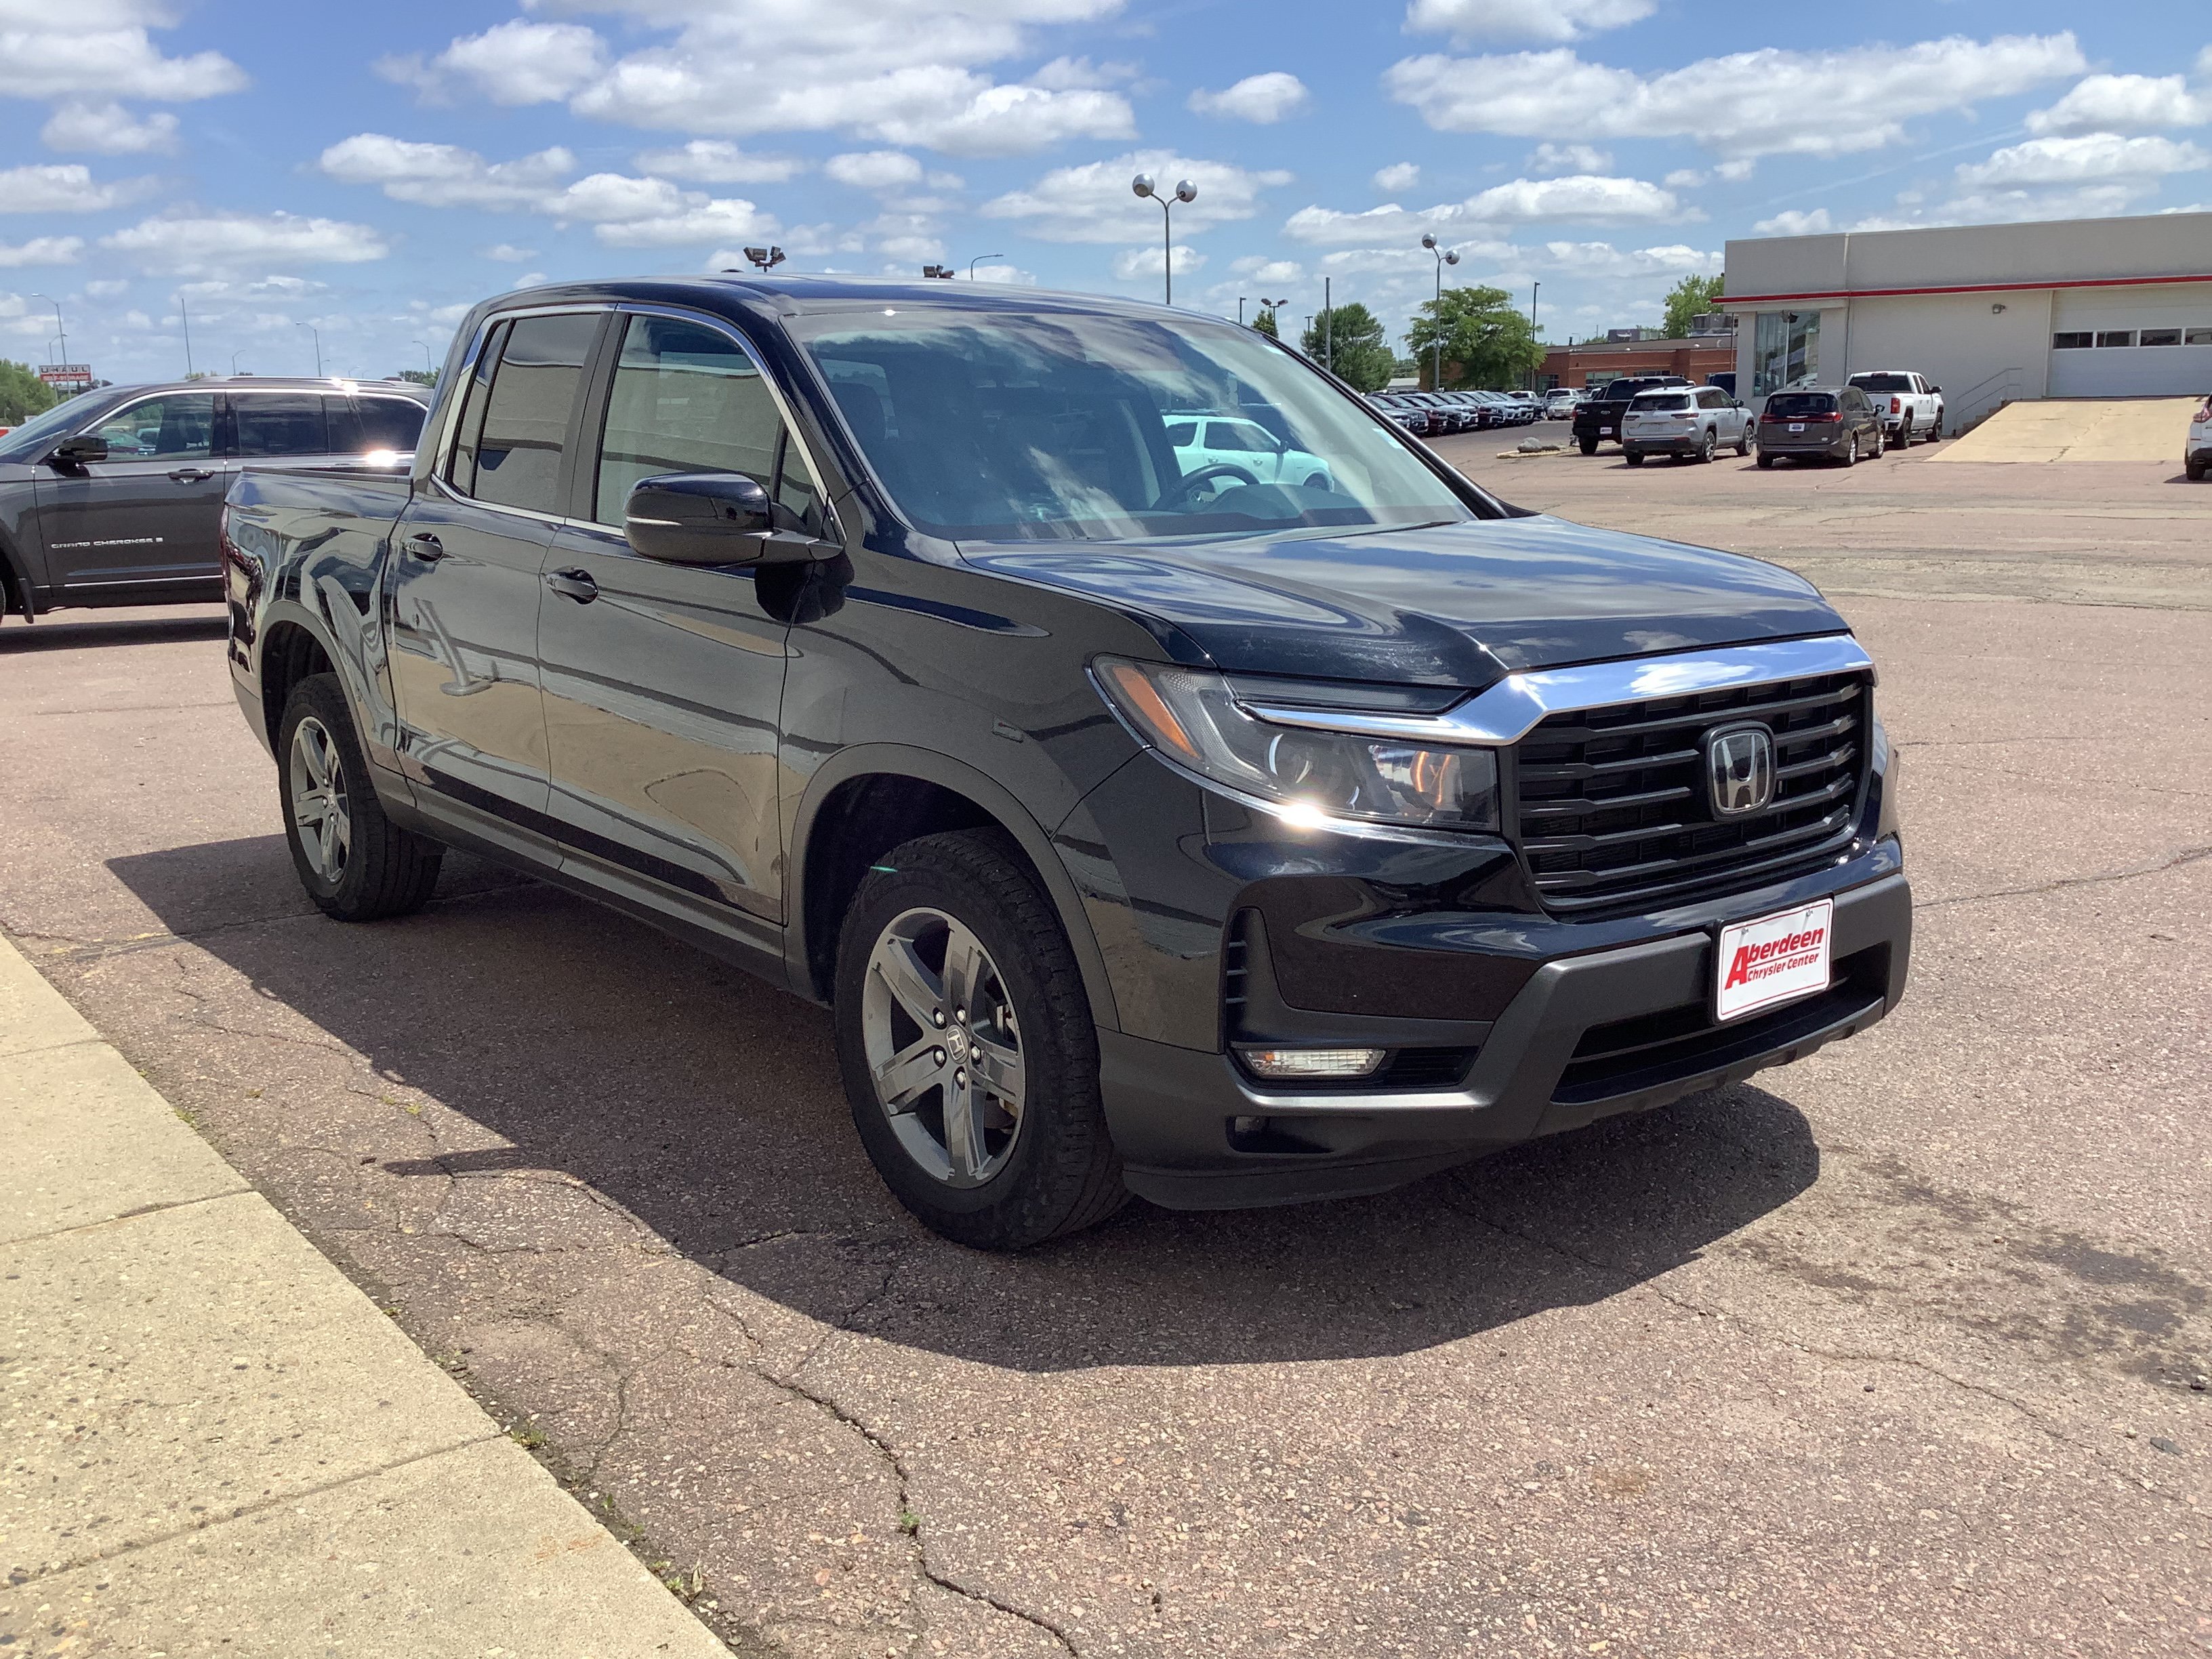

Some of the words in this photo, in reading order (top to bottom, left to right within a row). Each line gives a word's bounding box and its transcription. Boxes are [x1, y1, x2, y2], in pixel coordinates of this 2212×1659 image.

[94, 537, 153, 546] CHEROKEE
[1725, 928, 1824, 990] Aberdeen
[1748, 962, 1786, 981] Chrysler
[1787, 953, 1819, 970] Center
